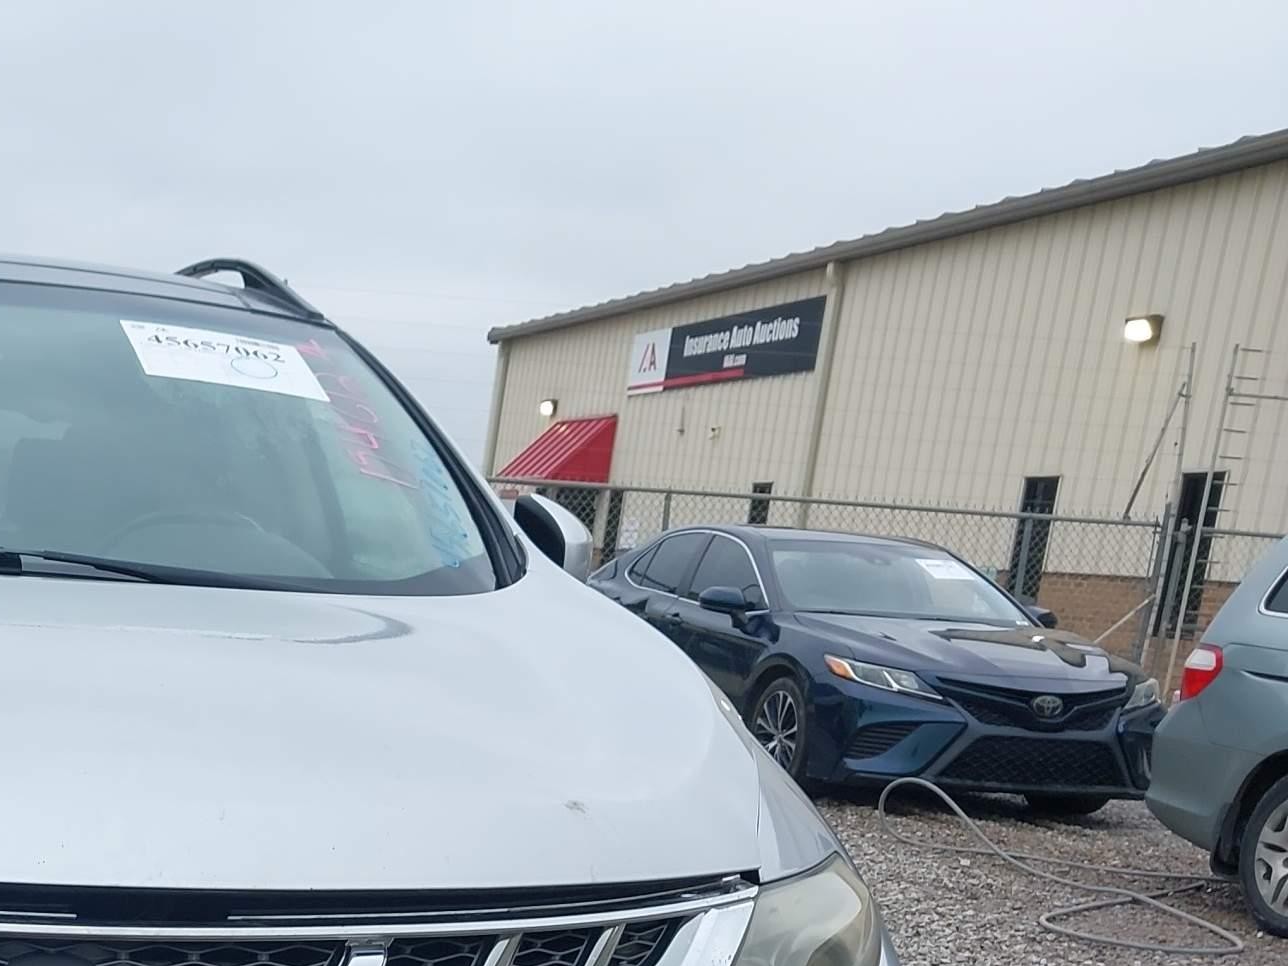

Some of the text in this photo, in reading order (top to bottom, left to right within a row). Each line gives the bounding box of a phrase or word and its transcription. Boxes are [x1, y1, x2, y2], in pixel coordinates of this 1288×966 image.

[147, 334, 286, 363] 45657062
[683, 317, 800, 357] Insurance Auto Auctions
